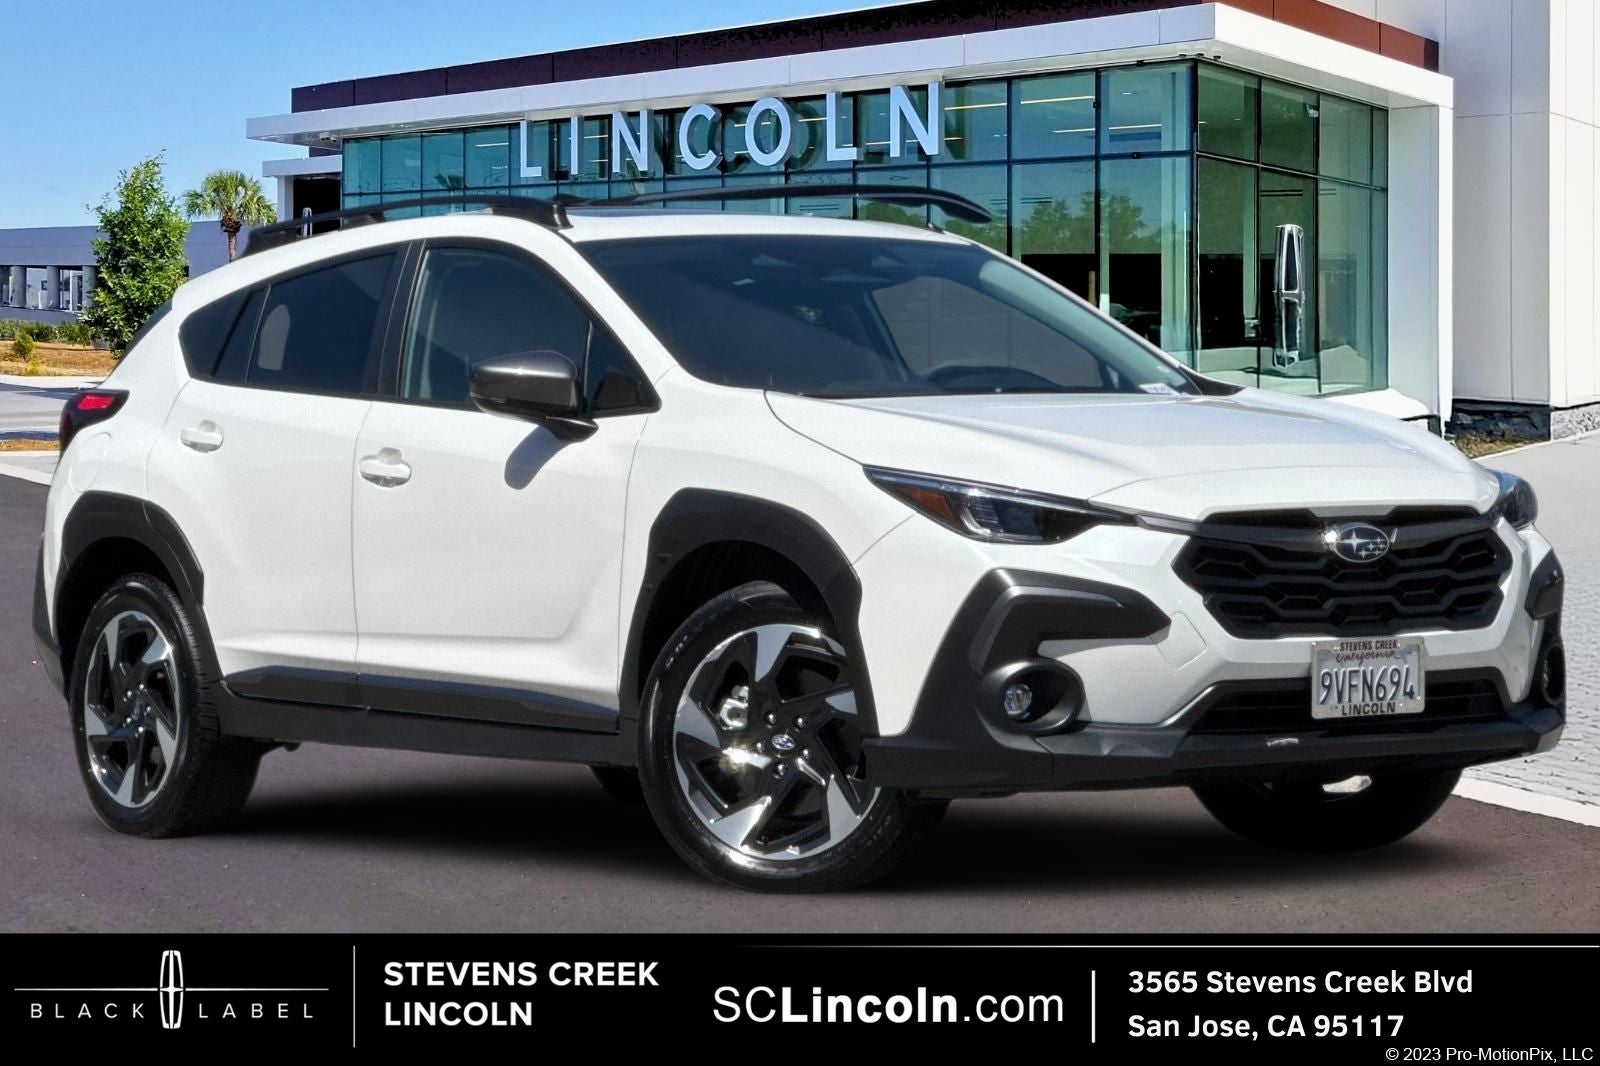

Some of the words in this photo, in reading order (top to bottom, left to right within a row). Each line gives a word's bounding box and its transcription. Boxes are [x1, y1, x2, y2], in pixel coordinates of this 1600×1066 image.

[519, 80, 943, 178] LINCOLN
[1340, 641, 1373, 652] STEVENS
[1375, 640, 1398, 650] CREEK
[1320, 665, 1415, 705] 9VFN694
[1341, 701, 1396, 716] LINCOLN
